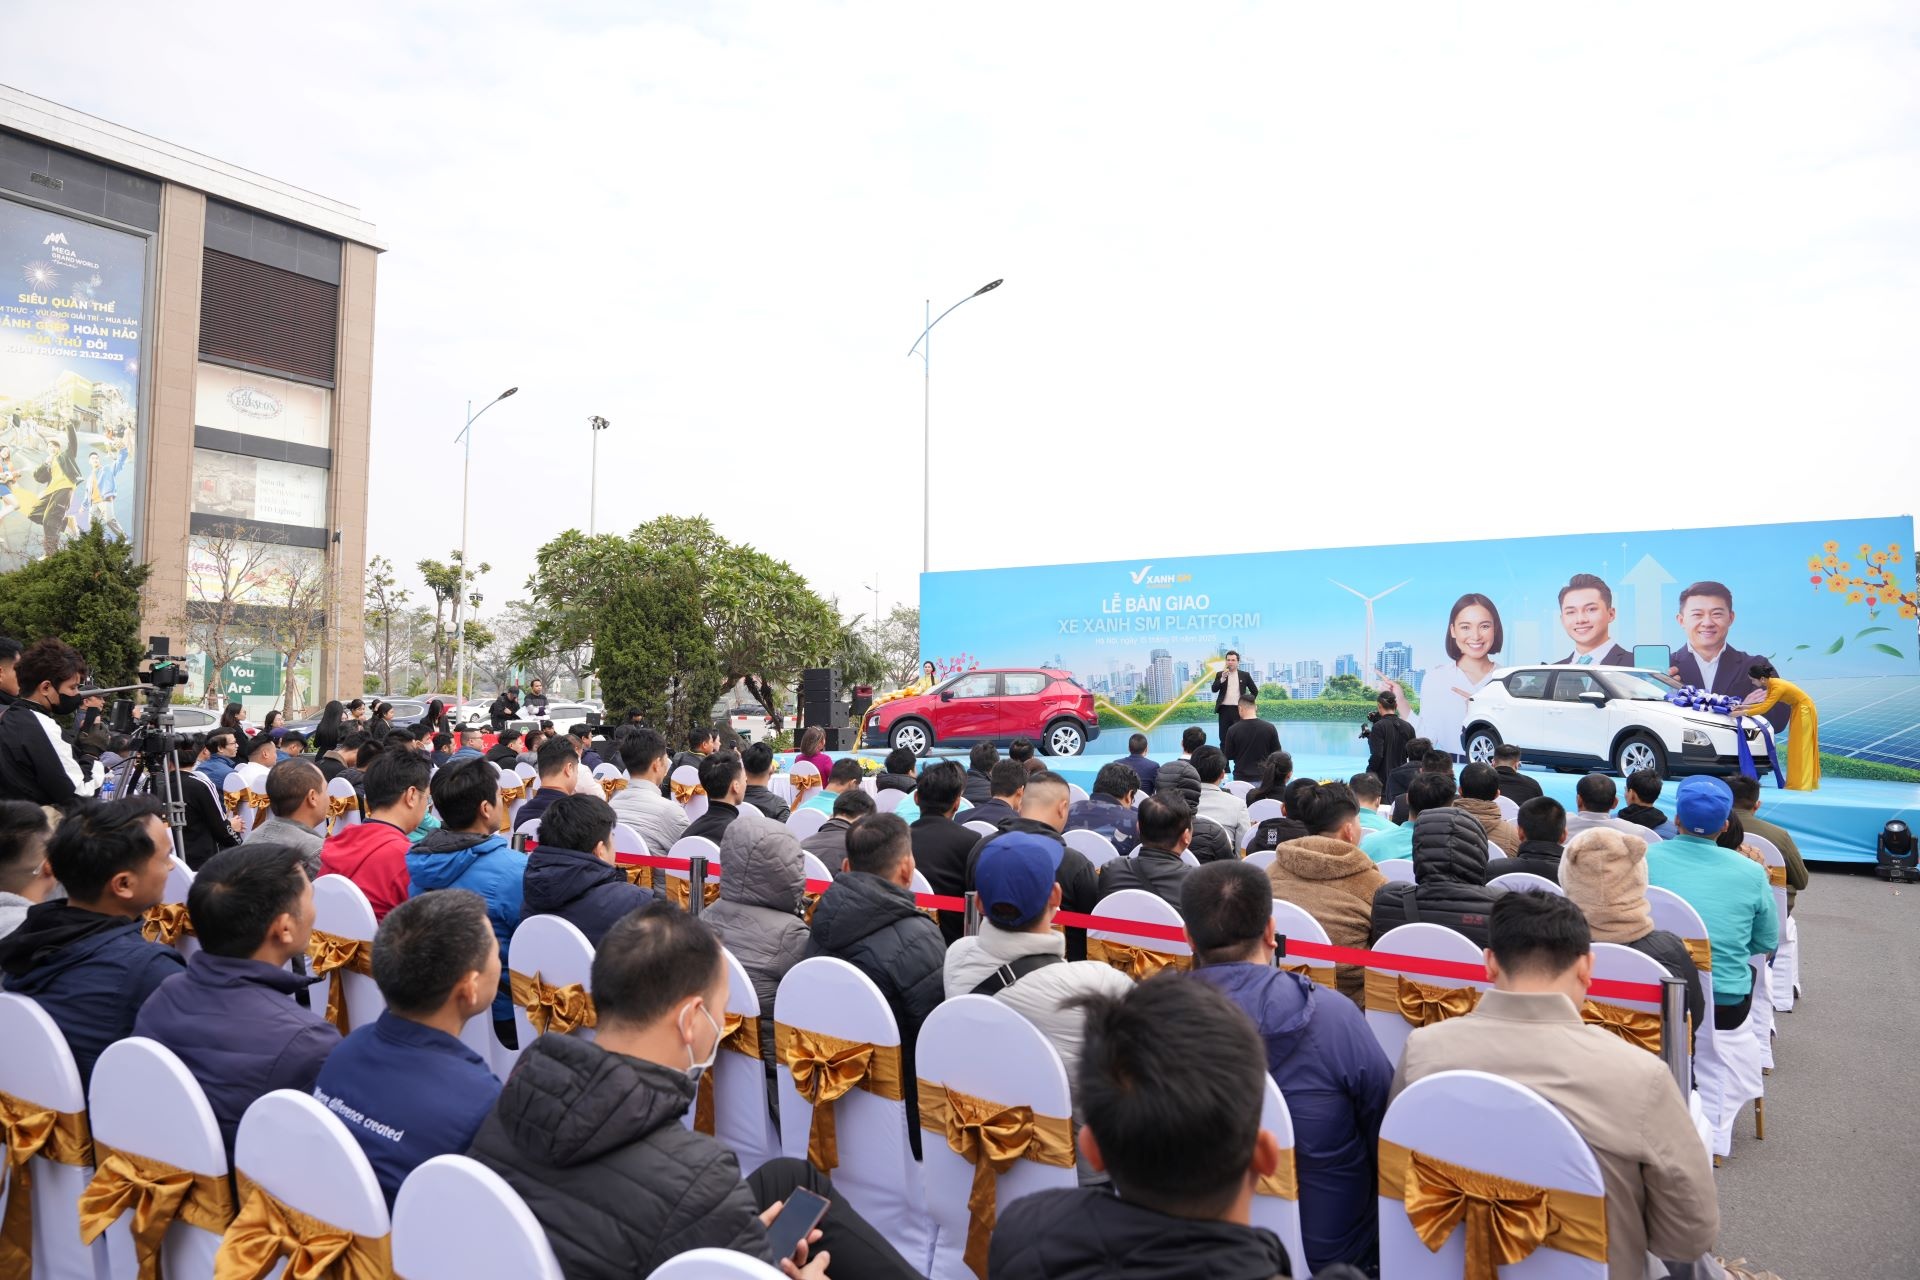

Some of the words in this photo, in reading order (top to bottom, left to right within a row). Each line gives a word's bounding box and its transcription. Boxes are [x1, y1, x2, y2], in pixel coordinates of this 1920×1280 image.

[51, 245, 77, 258] MEGA
[51, 252, 75, 263] GRAND
[75, 258, 100, 269] WORLD
[18, 292, 48, 305] SIÊU
[105, 316, 121, 325] MUA
[0, 314, 32, 329] ẢNH
[73, 323, 109, 338] HOÀN
[112, 326, 138, 341] HẢO
[79, 350, 124, 361] 21.12.2023
[1145, 574, 1175, 585] XANH
[1102, 592, 1121, 614] LỄ
[1125, 594, 1161, 613] BÀN
[1165, 594, 1210, 612] GIAO
[1058, 619, 1079, 634] XE
[1083, 617, 1130, 633] XANH
[1135, 616, 1160, 632] SM
[1165, 613, 1261, 631] PLATFORM
[229, 665, 255, 678] You
[363, 1118, 405, 1143] created
